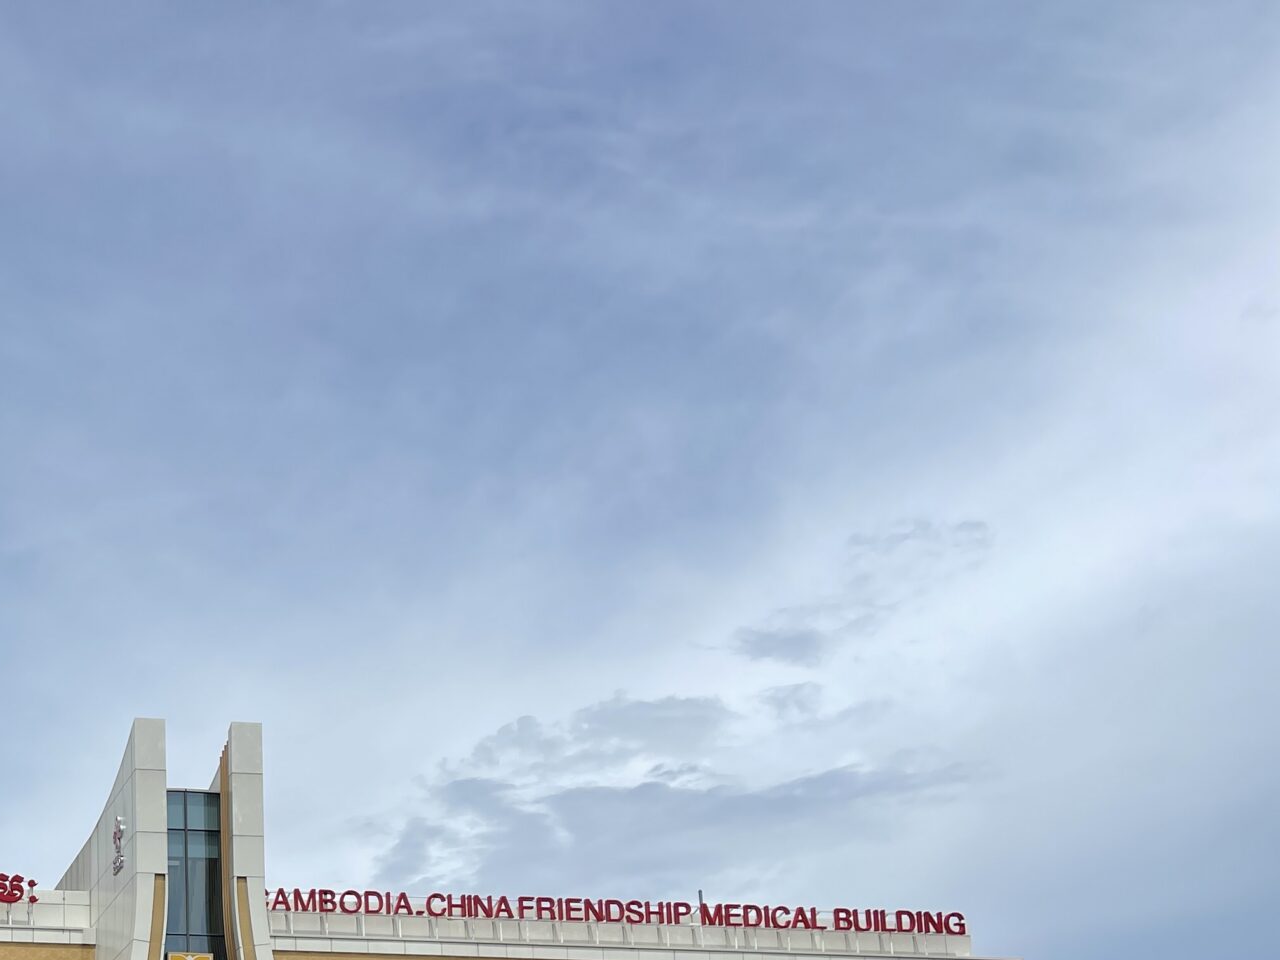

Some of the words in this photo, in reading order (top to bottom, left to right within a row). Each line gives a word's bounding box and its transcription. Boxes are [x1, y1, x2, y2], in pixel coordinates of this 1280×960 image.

[517, 896, 692, 925] FRIENDSHIP
[700, 903, 828, 930] MEDICAL
[833, 908, 967, 936] BUILDING
